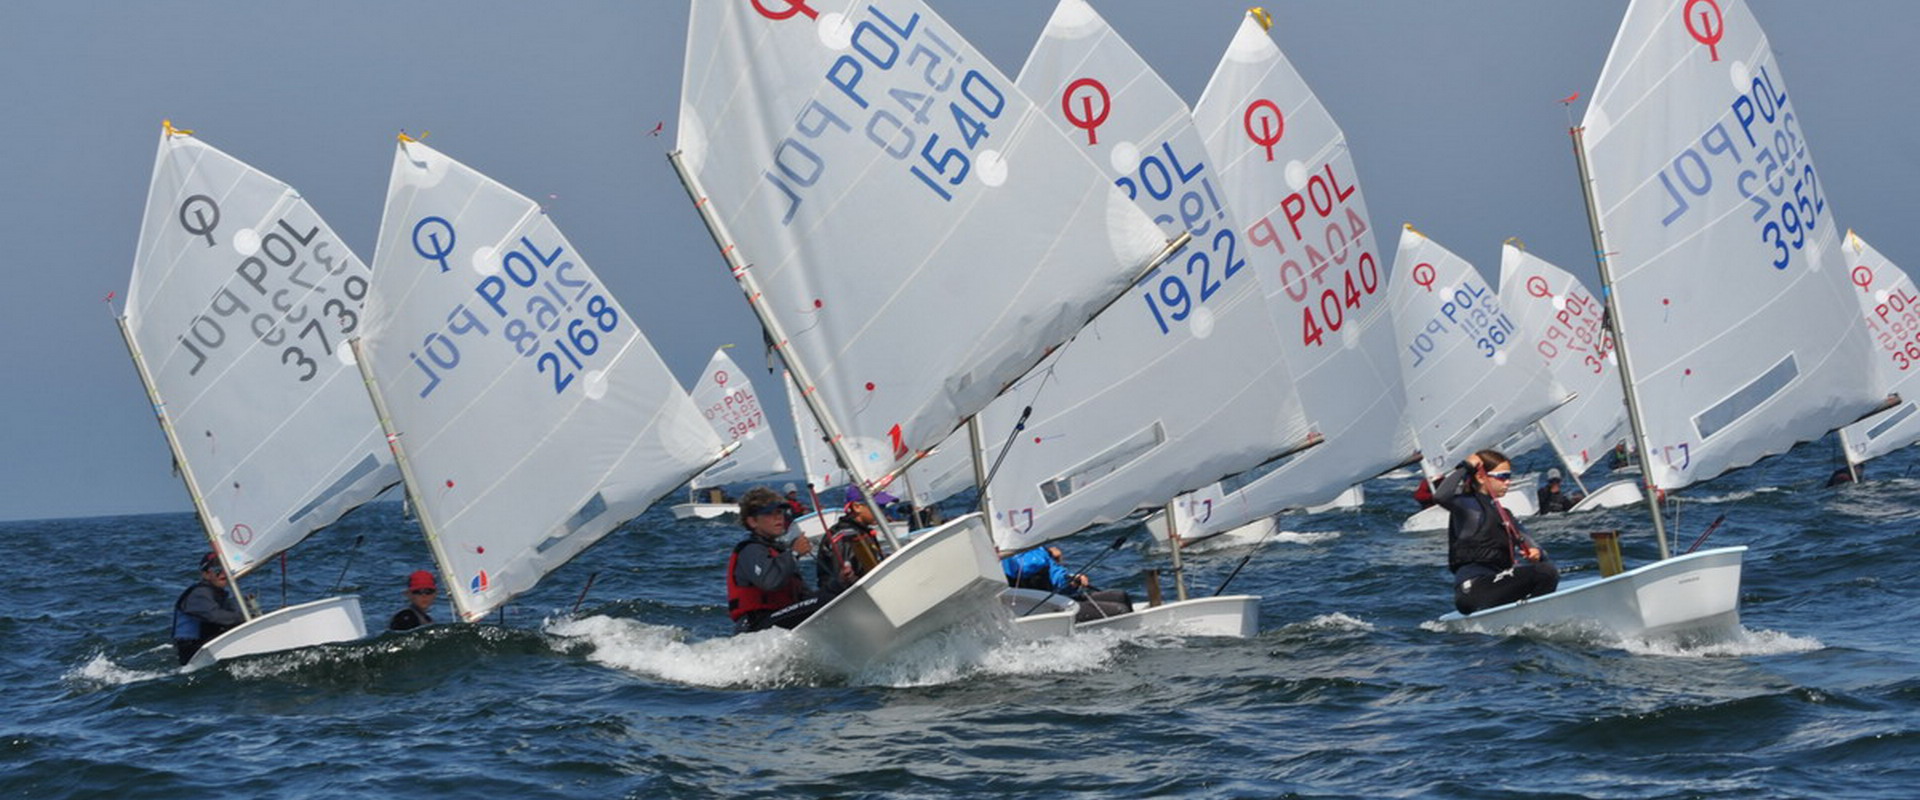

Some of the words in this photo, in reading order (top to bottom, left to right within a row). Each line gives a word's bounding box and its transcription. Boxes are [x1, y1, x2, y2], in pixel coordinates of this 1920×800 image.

[825, 5, 920, 110] POL
[910, 70, 1005, 202] 1540
[1732, 65, 1786, 148] POL
[1280, 163, 1355, 241] POL
[1763, 164, 1824, 270] 3952
[236, 218, 320, 296] POL
[475, 236, 564, 319] POL
[1144, 228, 1246, 336] 1922
[1304, 252, 1378, 347] 4040
[1441, 282, 1486, 325] POL
[1477, 313, 1515, 358] 3611
[1556, 291, 1590, 330] POL
[1874, 288, 1918, 325] POL
[537, 295, 619, 394] 2168
[723, 389, 753, 410] POL
[728, 411, 762, 440] 3947
